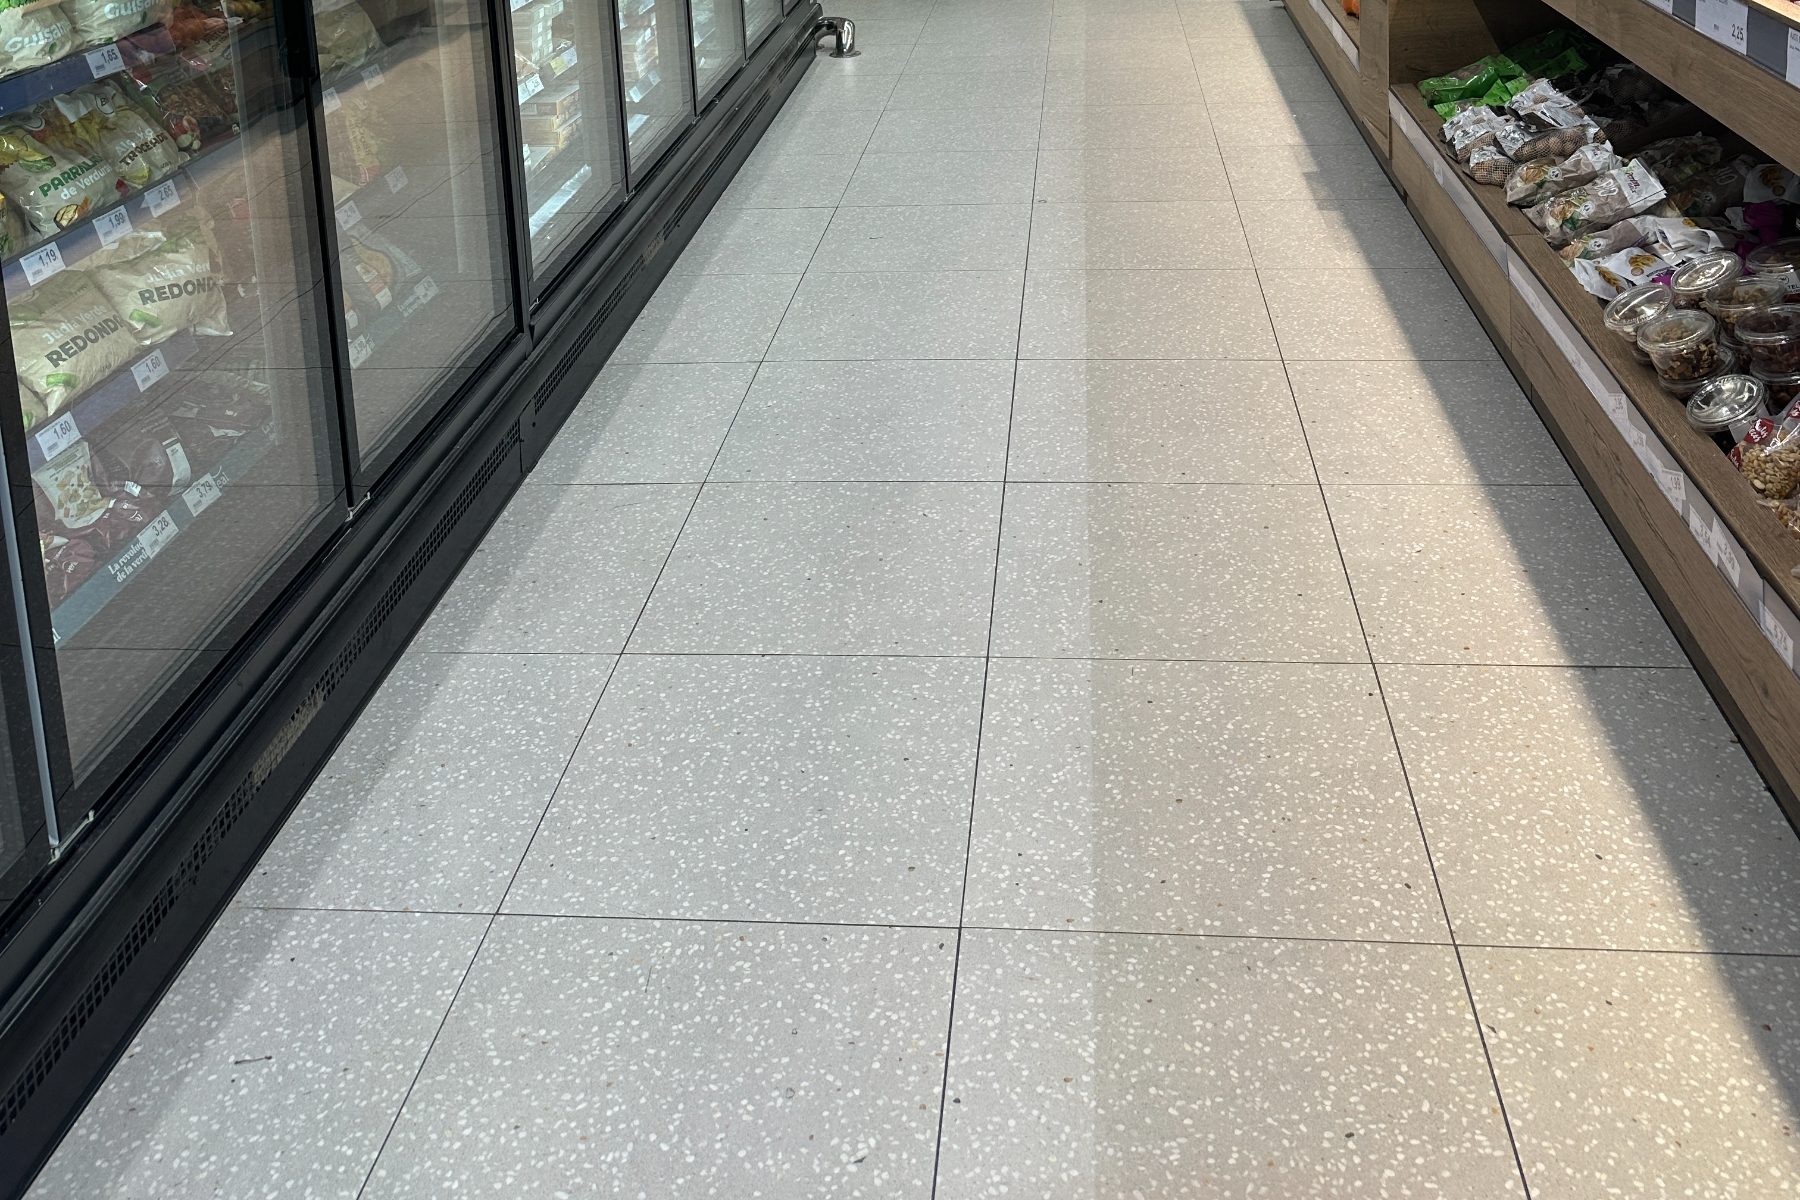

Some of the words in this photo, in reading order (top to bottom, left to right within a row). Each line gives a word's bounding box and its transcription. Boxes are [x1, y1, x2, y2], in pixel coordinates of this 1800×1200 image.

[5, 19, 68, 53] Guisan
[60, 185, 78, 201] de
[38, 248, 58, 268] 1,19
[138, 275, 218, 306] REDOND
[144, 355, 162, 375] 1,60
[53, 420, 72, 440] 1,60
[195, 480, 213, 499] 3,79
[151, 516, 170, 538] 3,28
[108, 561, 121, 575] La
[116, 569, 127, 583] de
